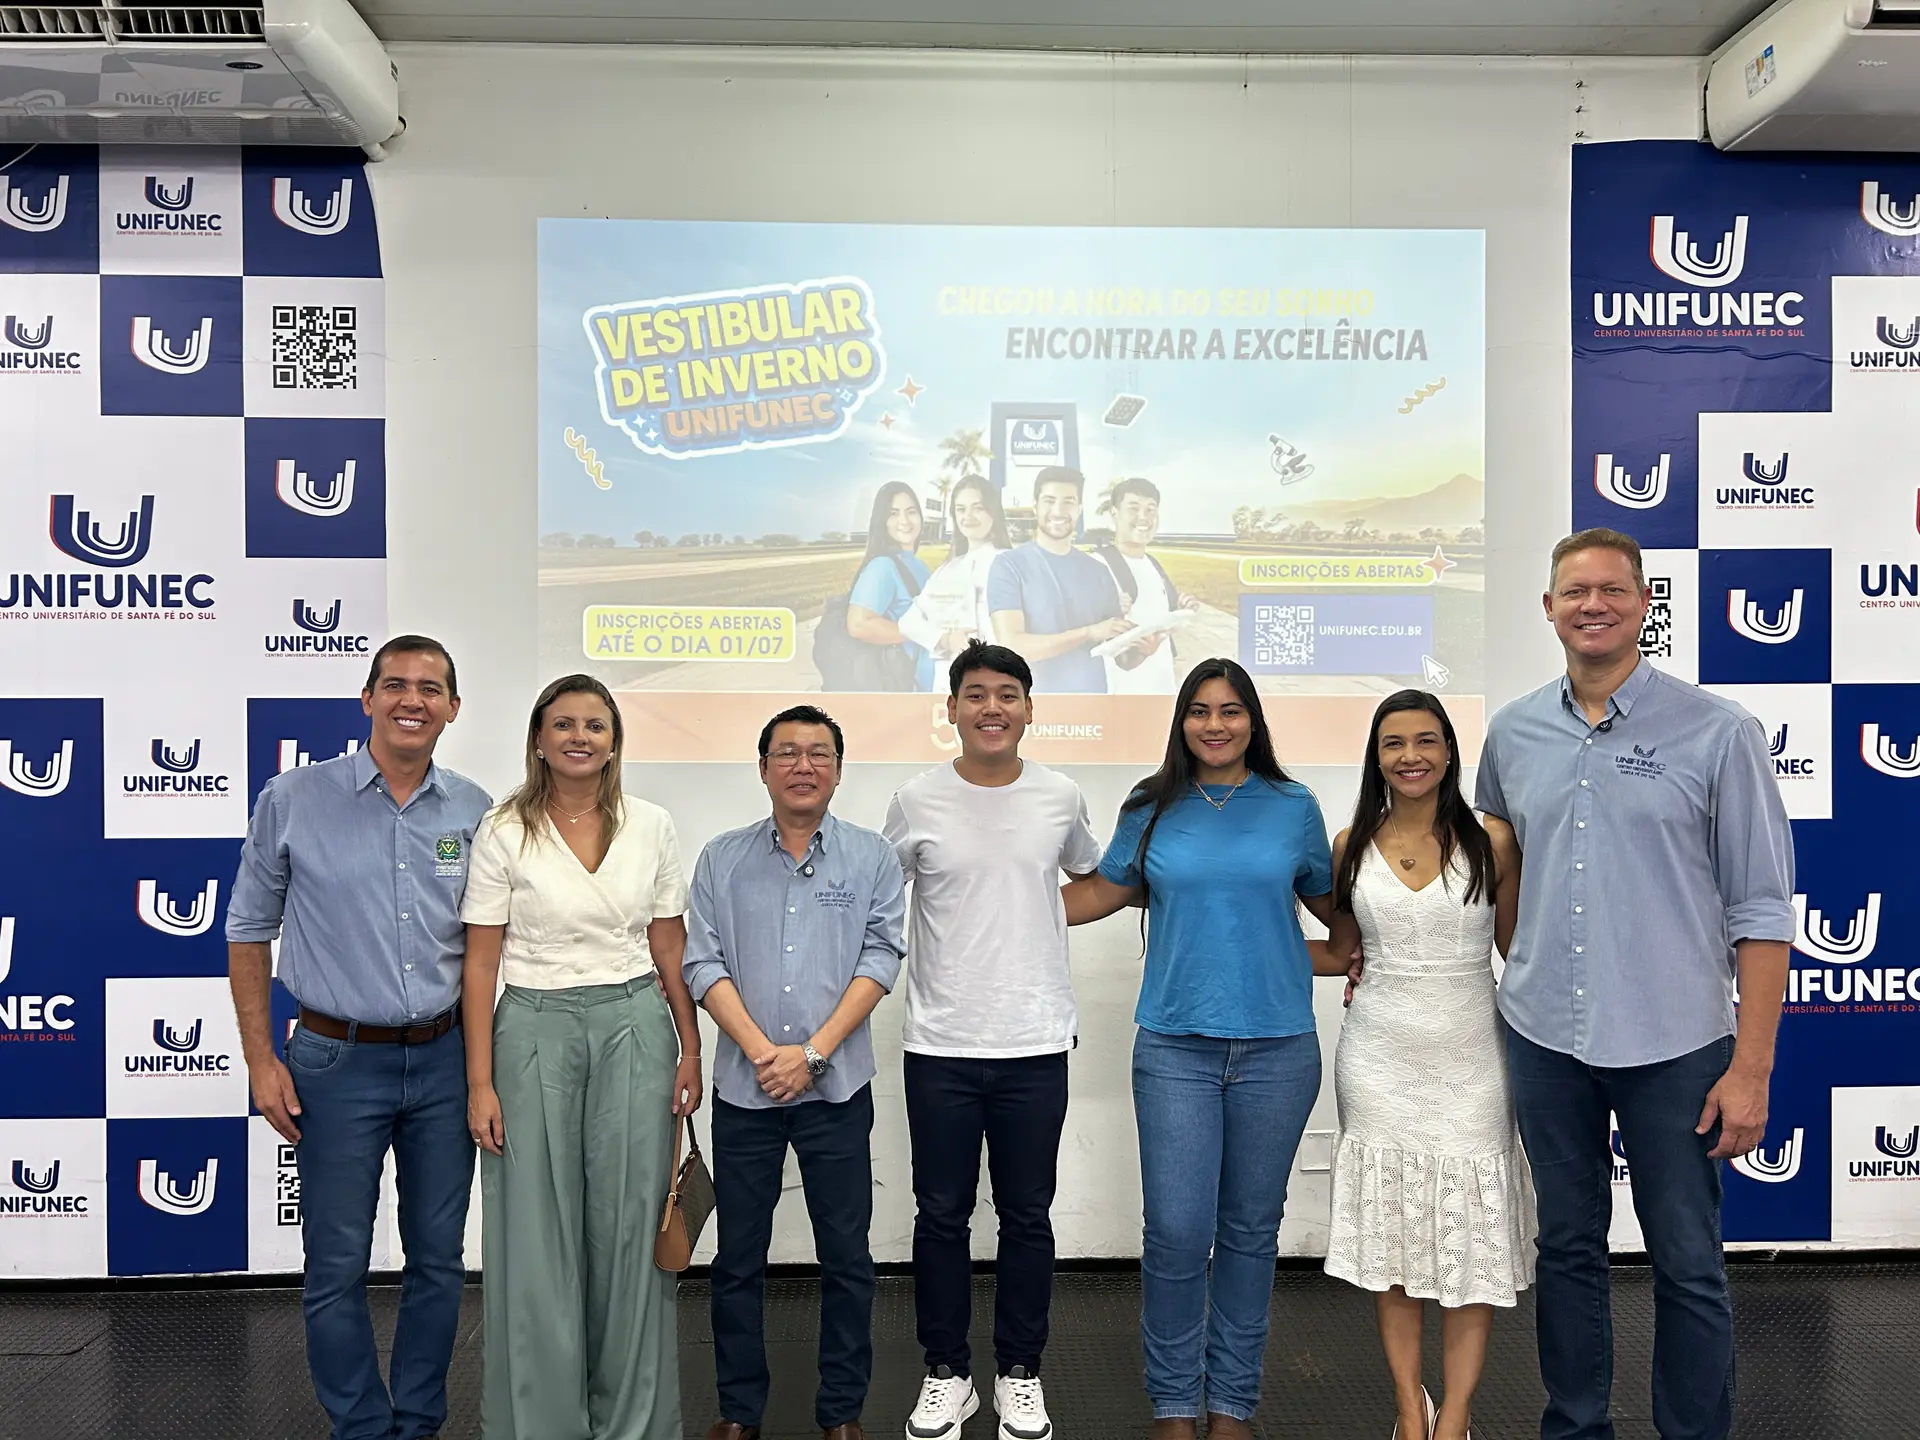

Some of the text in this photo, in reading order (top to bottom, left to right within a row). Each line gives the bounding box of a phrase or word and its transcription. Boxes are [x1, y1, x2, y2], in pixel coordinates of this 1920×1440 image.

[117, 213, 222, 231] UNIFUNEC
[938, 285, 1374, 317] CHEGOU A HORA DO SEU SONHO
[1594, 292, 1805, 326] UNIFUNEC
[595, 288, 866, 361] VESTIBULAR
[1634, 327, 1703, 337] UNIVERSITÁRIO
[1756, 327, 1767, 337] FÉ
[1005, 318, 1428, 361] ENCONTRAR A EXCELÊNCIA
[1851, 352, 1920, 367] UNIFUN
[609, 340, 874, 408] DE INVERNO
[666, 393, 836, 438] UNIFUNEC
[1013, 441, 1056, 450] UNIFUNEC
[1716, 488, 1814, 504] UNIFUNEC
[1251, 561, 1424, 581] INSCRIÇÕES ABERTAS
[0, 574, 215, 608] UNIFUNEC
[33, 610, 107, 620] UNIVERSITÁRIO
[111, 612, 123, 620] DE
[127, 612, 160, 620] SANTA
[165, 610, 175, 620] FÉ
[180, 612, 194, 620] DO
[198, 612, 216, 620] SUL
[596, 610, 783, 633] INSCRIÇÕES ABERTAS
[1319, 625, 1422, 636] UNIFUNEC.EDU.BR
[265, 636, 369, 652] UNIFUNEC
[596, 629, 784, 656] ATÉ O DIA 01/07
[1032, 724, 1103, 737] UNIFUNEC
[1615, 756, 1666, 770] UNIFUNEC
[123, 776, 229, 792] UNIFUNEC
[1783, 1003, 1835, 1014] VERSITÁRIO
[1839, 1005, 1850, 1013] DE
[1854, 1005, 1884, 1013] SANTA
[1888, 1003, 1898, 1012] FÉ
[24, 1032, 34, 1041] FÉ
[125, 1055, 230, 1072] UNIFUNEC
[1849, 1161, 1920, 1177] UNIFUN
[0, 1196, 88, 1212] NIFUNEC
